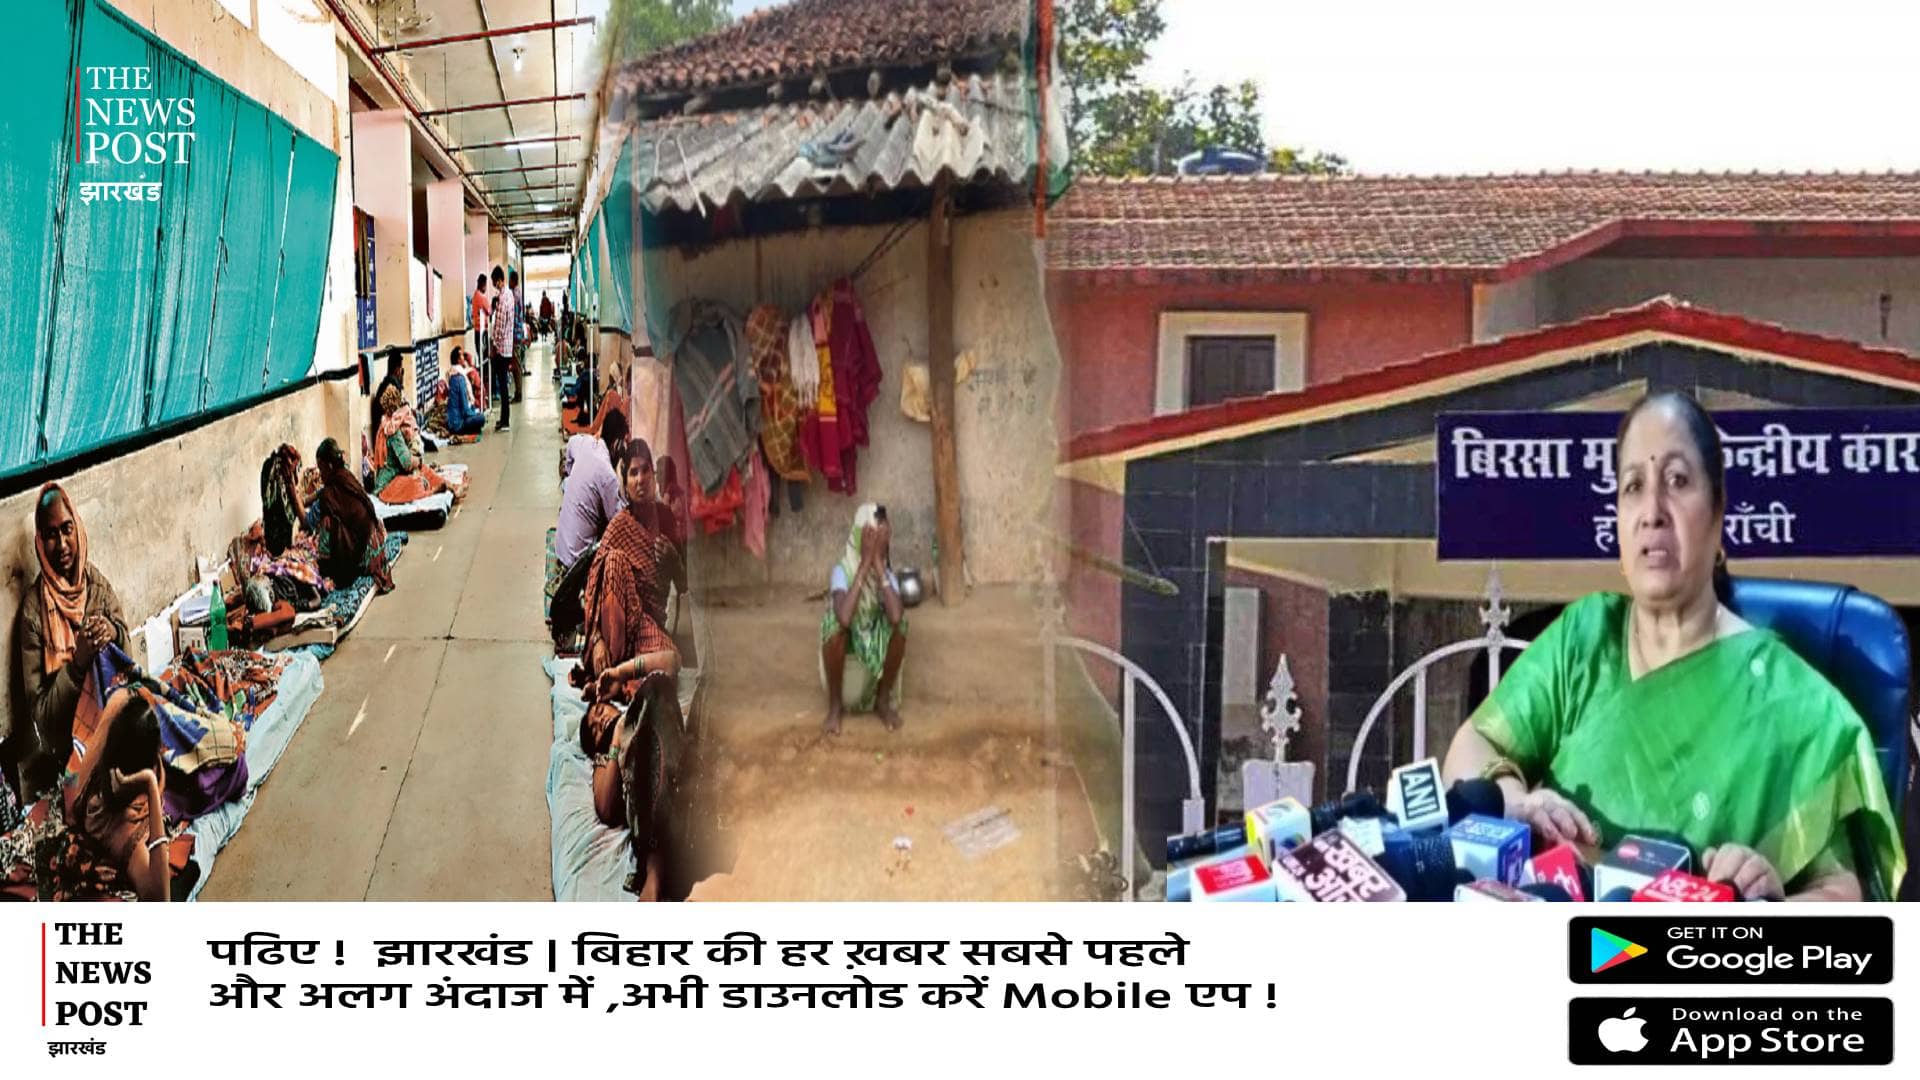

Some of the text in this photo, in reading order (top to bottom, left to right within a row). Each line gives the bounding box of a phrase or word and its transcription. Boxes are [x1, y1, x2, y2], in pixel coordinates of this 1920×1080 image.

[1452, 427, 1573, 478] बिरसा
[1581, 438, 1618, 494] मु
[1402, 773, 1437, 818] ANI
